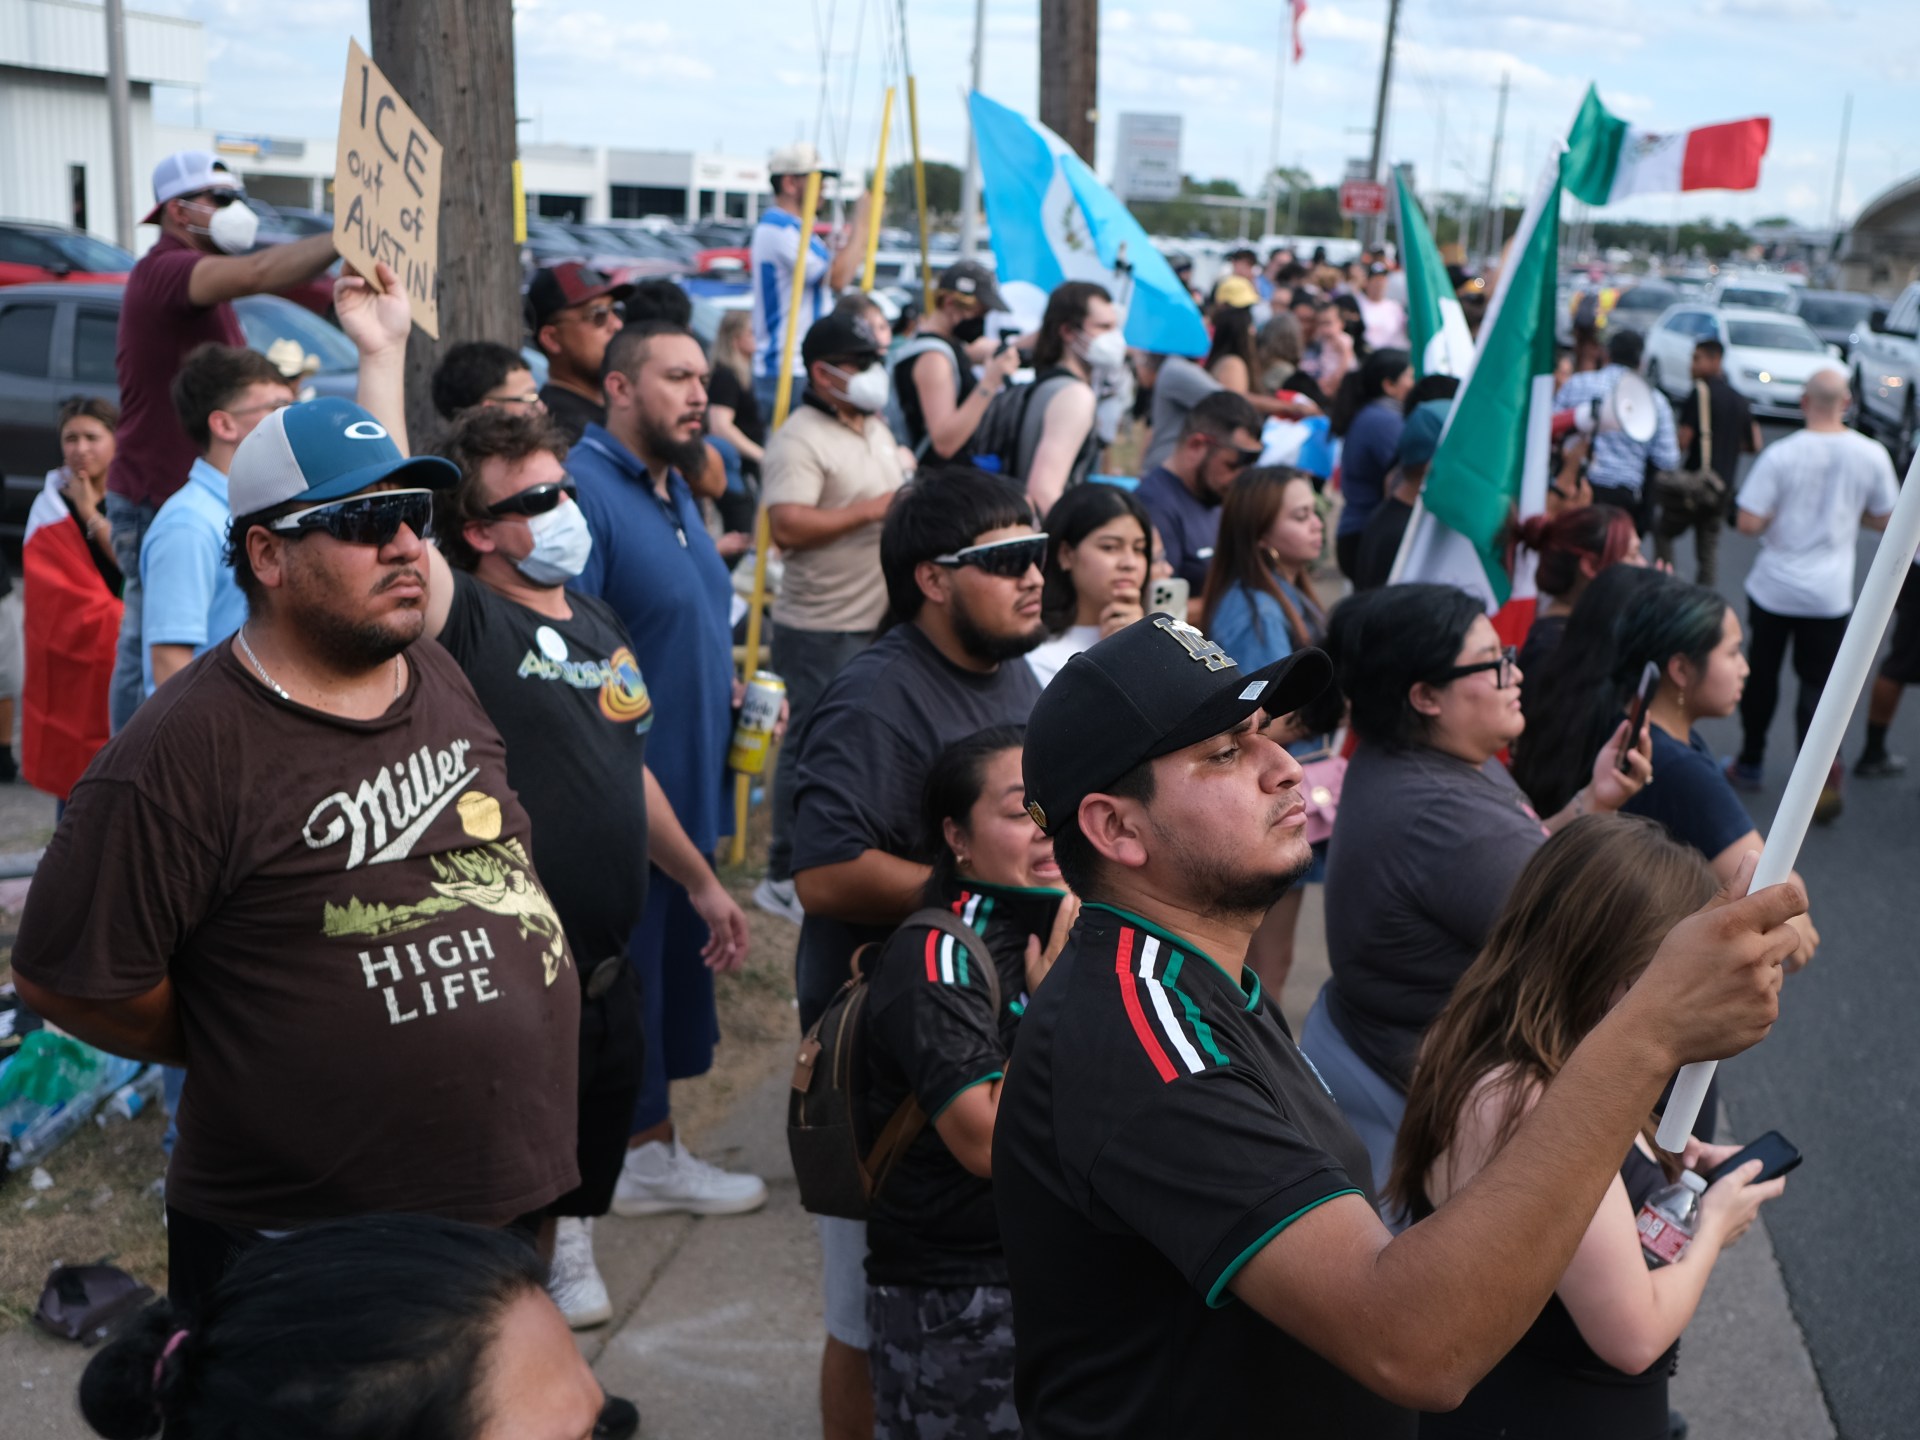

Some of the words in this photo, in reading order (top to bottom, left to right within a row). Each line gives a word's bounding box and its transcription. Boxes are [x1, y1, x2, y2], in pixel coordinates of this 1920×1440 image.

[361, 64, 429, 198] ICE
[348, 149, 383, 202] out
[401, 206, 425, 243] of
[302, 738, 471, 870] Miller
[358, 927, 495, 988] HIGH
[382, 967, 499, 1024] LIFE
